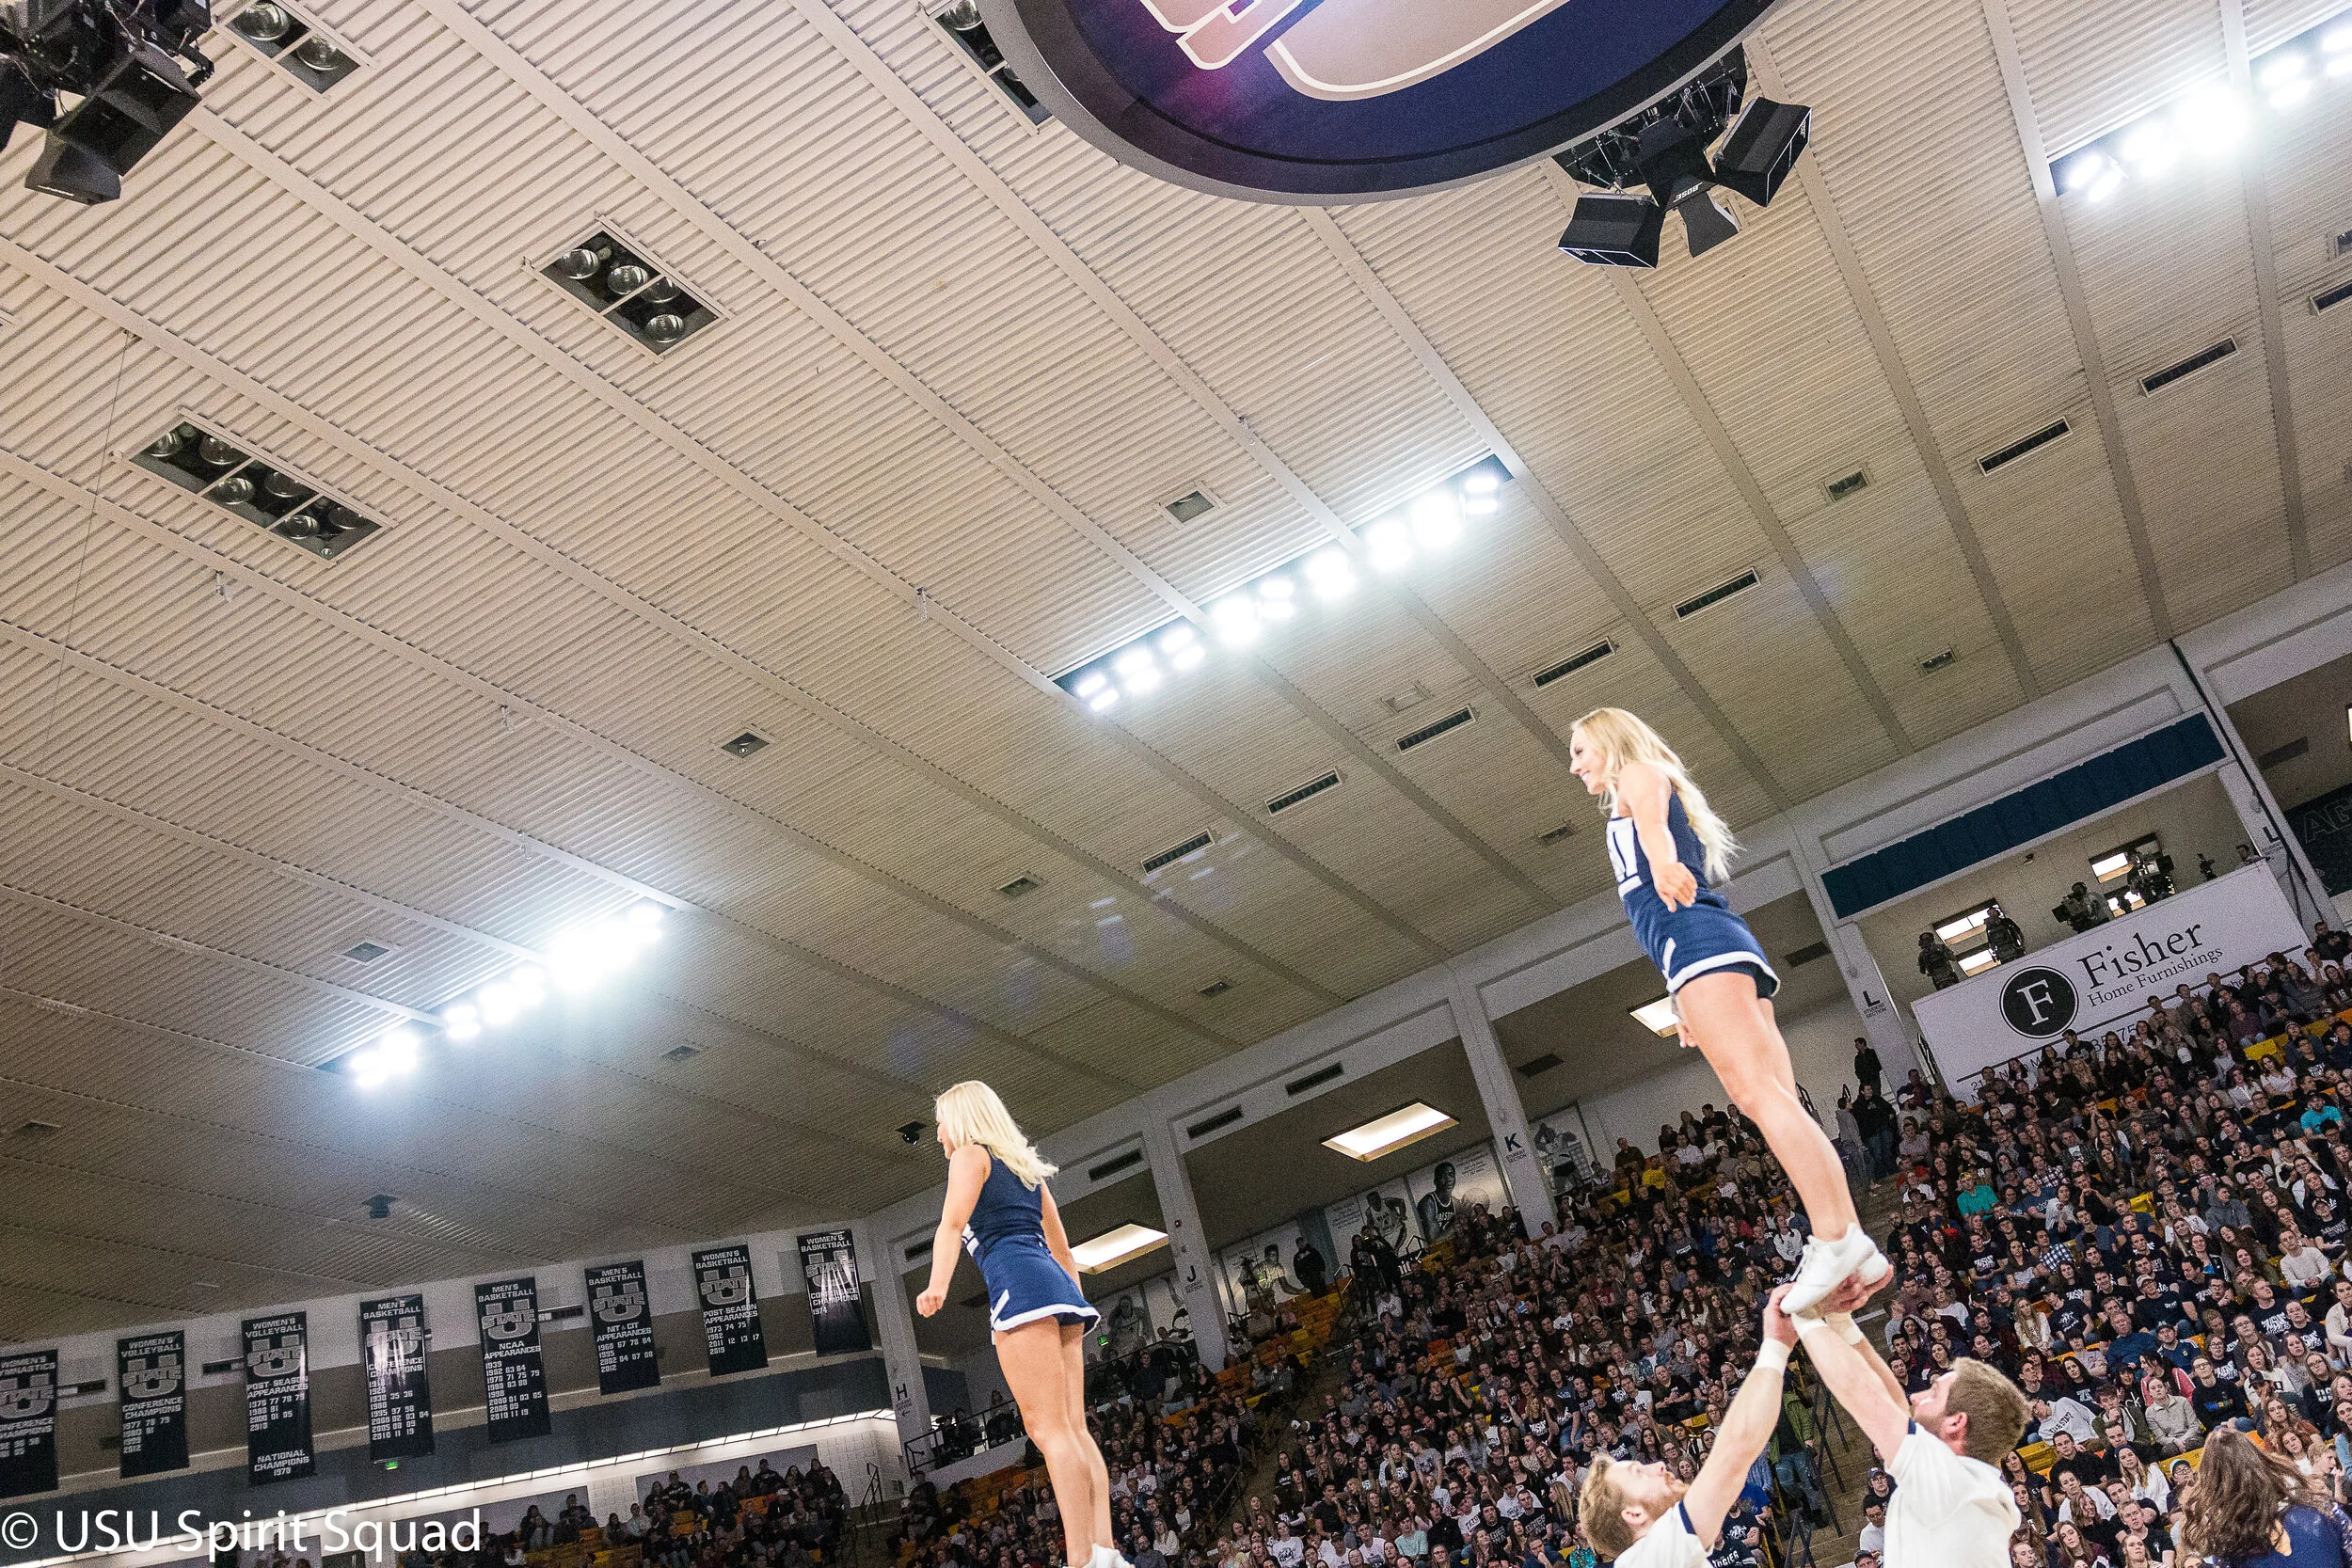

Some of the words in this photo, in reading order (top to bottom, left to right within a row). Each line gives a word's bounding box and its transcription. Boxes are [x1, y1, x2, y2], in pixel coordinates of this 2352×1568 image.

[1673, 182, 1703, 203] BOSE
[2077, 924, 2203, 990] Fisher
[2087, 982, 2135, 1007] Home
[2135, 948, 2224, 989] Furnishings
[1863, 990, 1880, 1007] L
[2017, 979, 2053, 1026] F
[1504, 1132, 1522, 1152] K
[801, 1240, 851, 1252] BASKETBALL
[696, 1256, 748, 1269] BASKETBALL
[702, 1250, 739, 1261] WOMEN'S
[588, 1272, 642, 1285] BASKETBALL
[602, 1267, 628, 1276] MEN'S
[1187, 1265, 1196, 1283] J
[493, 1283, 518, 1293] MEN'S
[478, 1289, 534, 1302] BASKETBALL
[593, 1292, 645, 1313] STATE
[363, 1306, 421, 1319] BASKETBALL
[726, 1303, 757, 1315] SEASON
[812, 1307, 827, 1315] 1974
[253, 1318, 295, 1330] WOMEN'S
[481, 1309, 535, 1330] STATE
[705, 1310, 758, 1325] APPEARANCES
[246, 1324, 303, 1338] VOLLEYBALL
[596, 1327, 652, 1342] APPEARANCES
[707, 1325, 722, 1334] 1973
[129, 1337, 173, 1349] WOMEN'S
[499, 1341, 524, 1350] NCAA
[121, 1344, 181, 1357] VOLLEYBALL
[484, 1346, 541, 1360] APPEARANCES
[0, 1362, 56, 1376] YMNASTICS
[122, 1365, 182, 1387] STATE
[247, 1384, 308, 1399] APPEARANCES
[896, 1383, 907, 1401] H
[122, 1397, 183, 1412] CONFERENCE
[125, 1405, 181, 1420] CHAMPIONS
[0, 1417, 54, 1432] ONFERENCE
[0, 1425, 52, 1439] HAMPIONS
[257, 1449, 305, 1463] NATIONAL
[254, 1456, 309, 1472] CHAMPIONS
